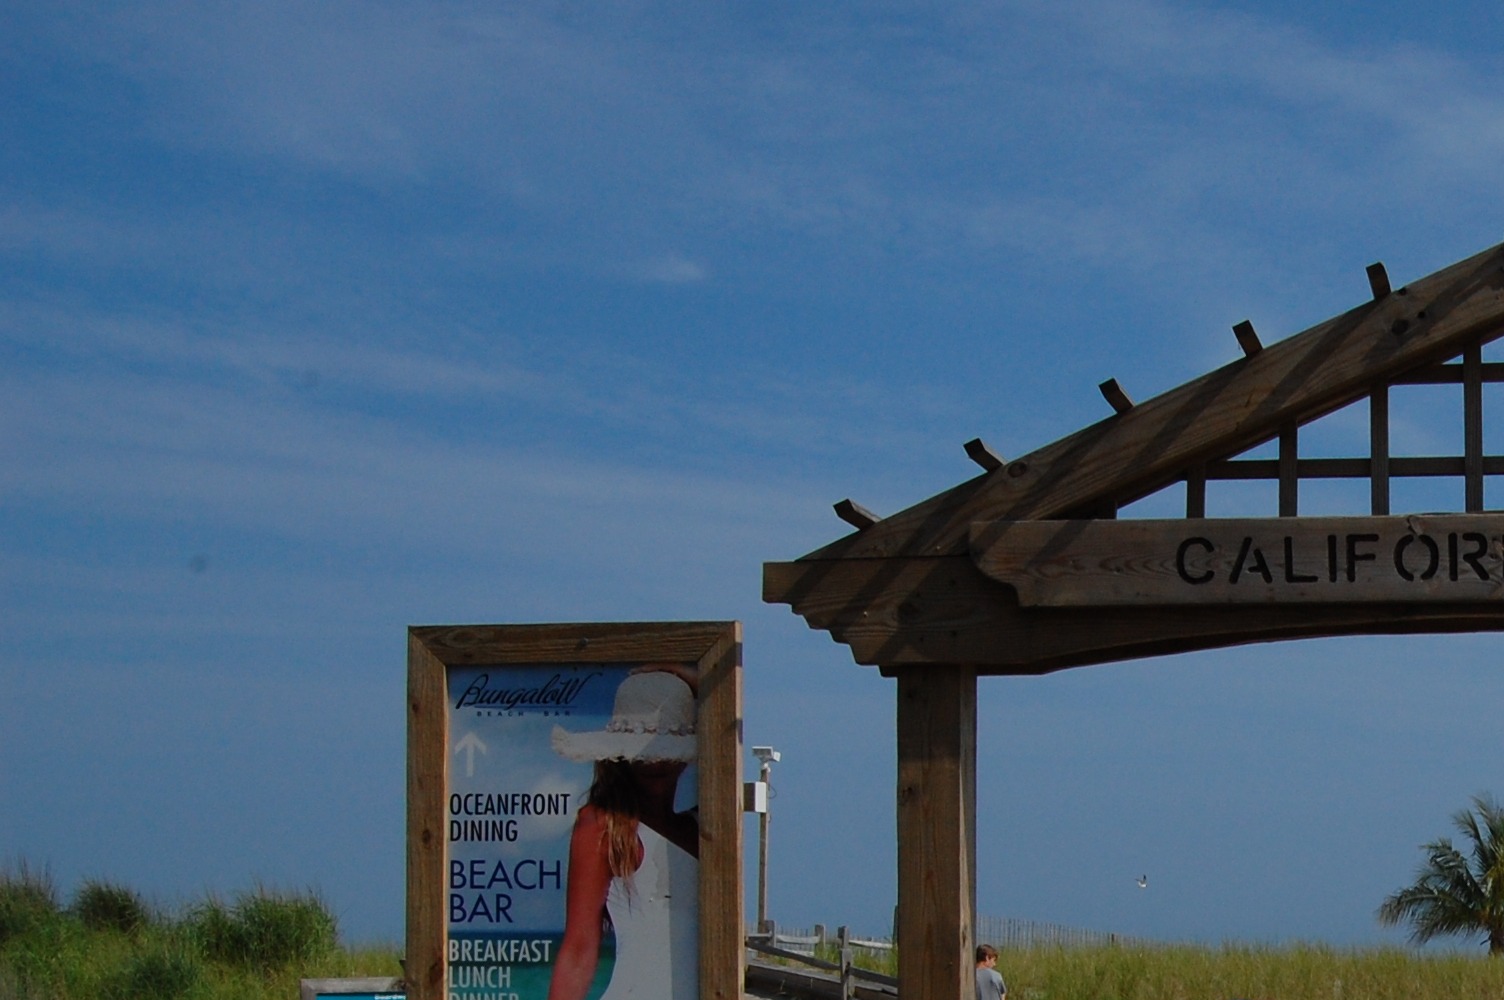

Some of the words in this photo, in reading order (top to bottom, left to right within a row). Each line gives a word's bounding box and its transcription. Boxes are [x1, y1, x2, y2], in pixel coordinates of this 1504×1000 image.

[450, 793, 571, 816] OCEANFRONT
[450, 820, 518, 842] DINING
[450, 860, 561, 890] BEACH
[450, 893, 513, 923] BAR
[449, 939, 552, 963] BREAKFAST
[449, 966, 511, 989] LUNCH
